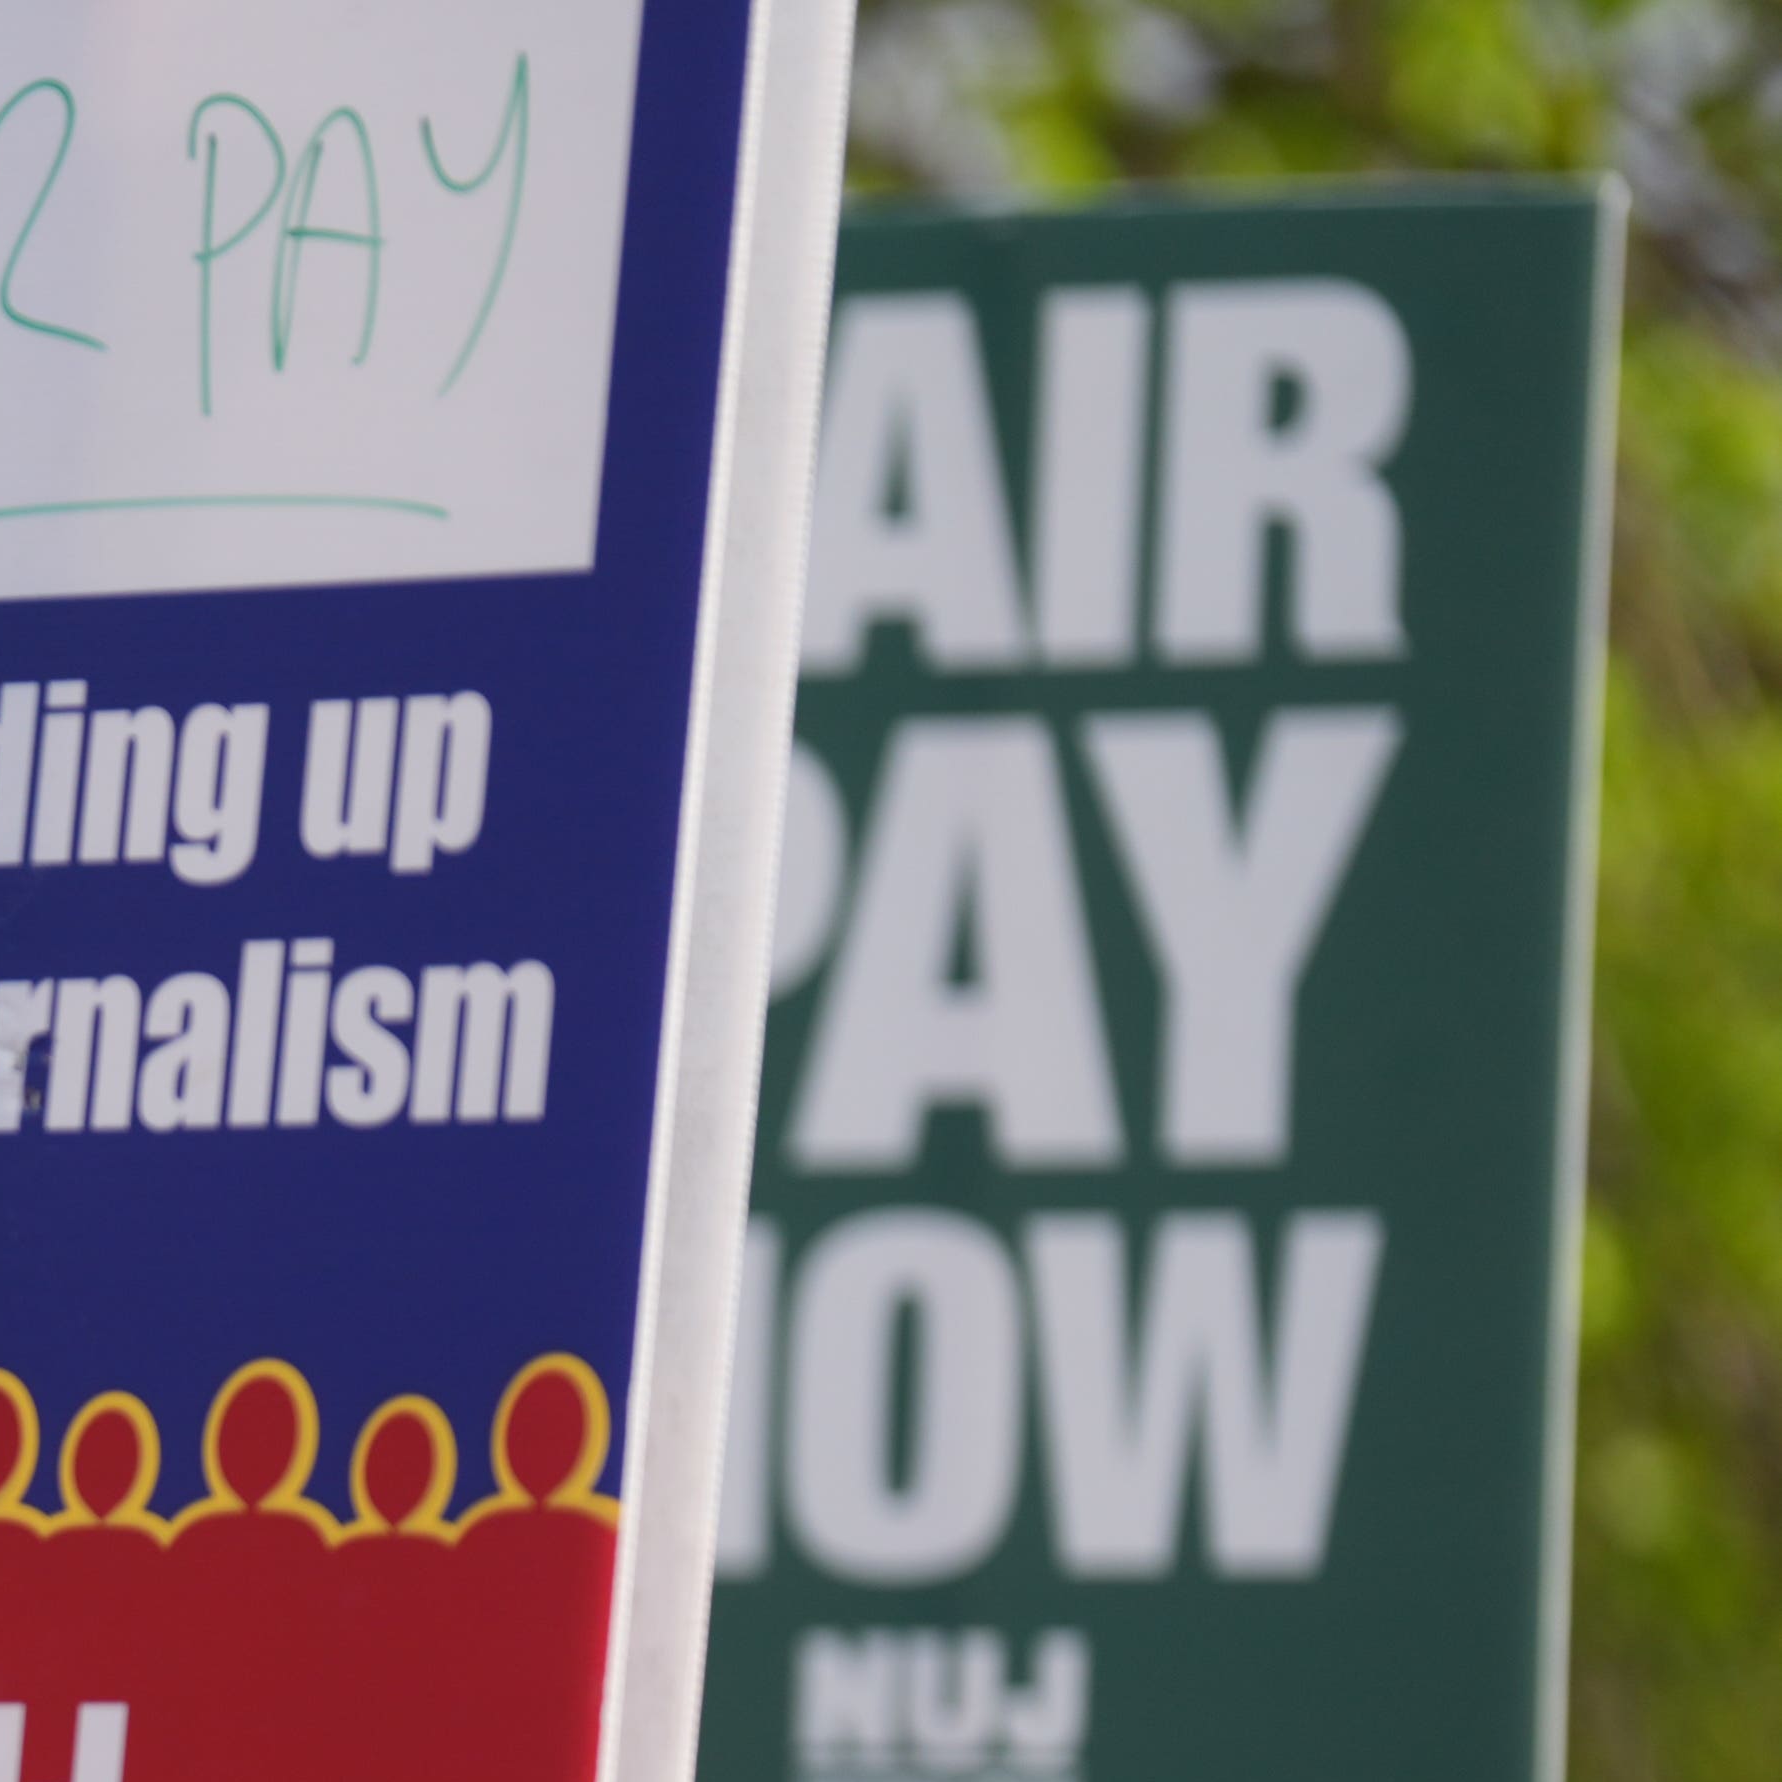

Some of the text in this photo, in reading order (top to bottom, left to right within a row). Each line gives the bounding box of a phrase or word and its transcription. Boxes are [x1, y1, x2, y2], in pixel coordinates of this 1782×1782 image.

[187, 50, 528, 417] PAY
[795, 273, 1416, 674] AIR
[299, 689, 493, 874] up
[792, 1624, 1092, 1774] NUJ
